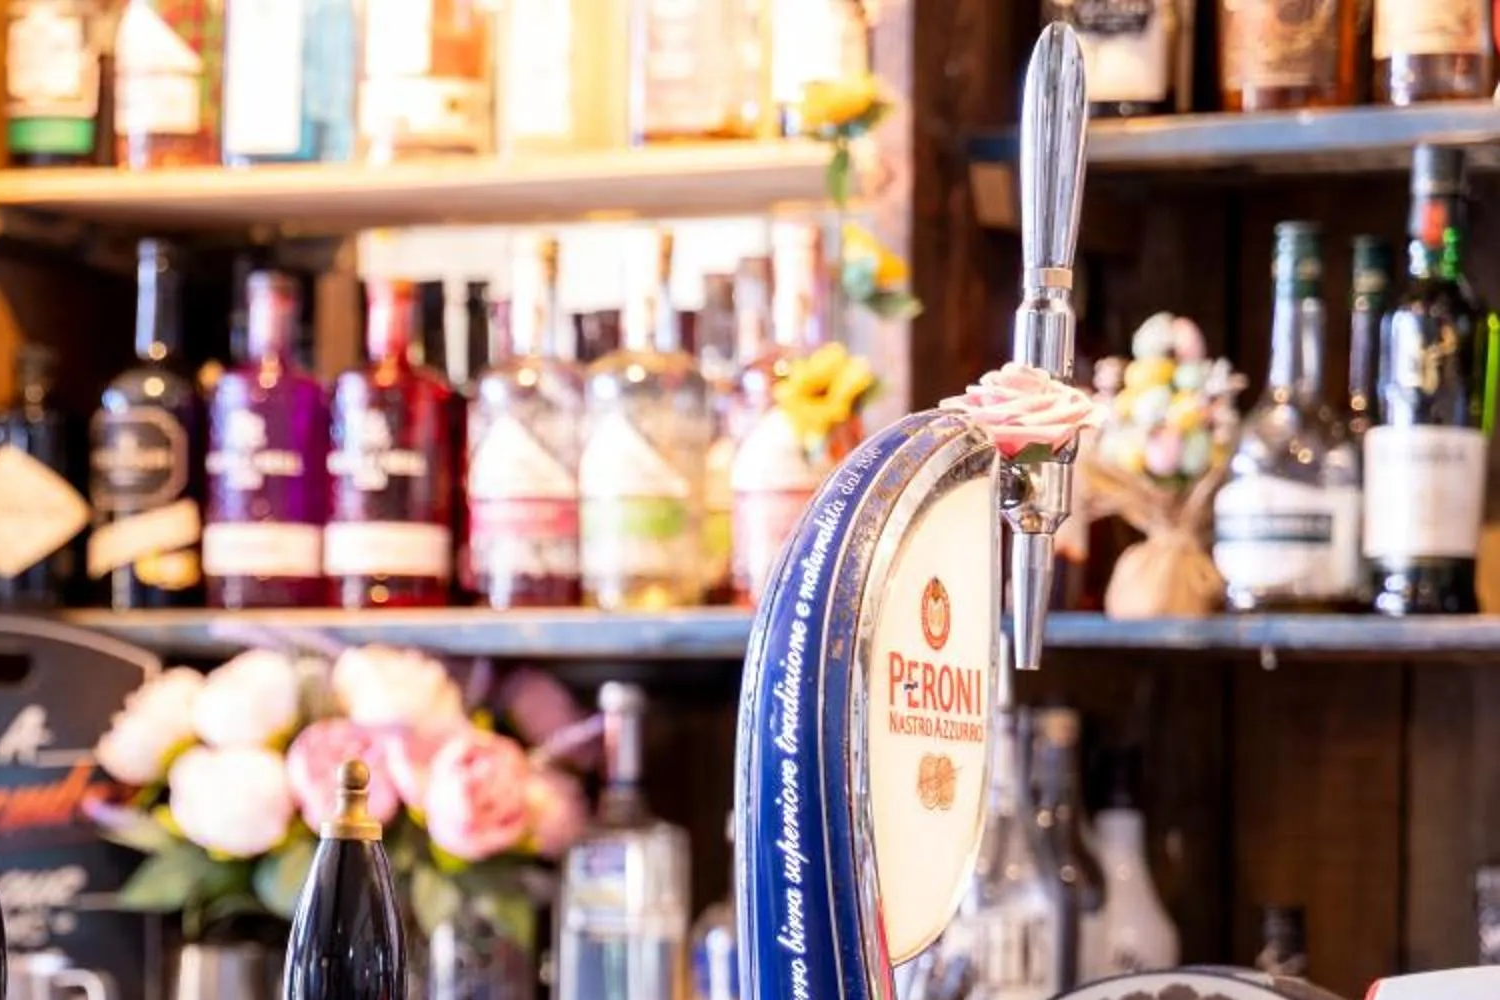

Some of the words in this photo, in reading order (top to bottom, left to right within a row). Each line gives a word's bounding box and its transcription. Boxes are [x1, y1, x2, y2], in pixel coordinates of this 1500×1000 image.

[835, 470, 859, 495] dal
[796, 601, 811, 618] e
[773, 620, 808, 754] tradizione
[888, 651, 981, 716] PERONI
[889, 711, 932, 738] NASTRO
[774, 759, 810, 883] superiore
[776, 887, 807, 954] birra
